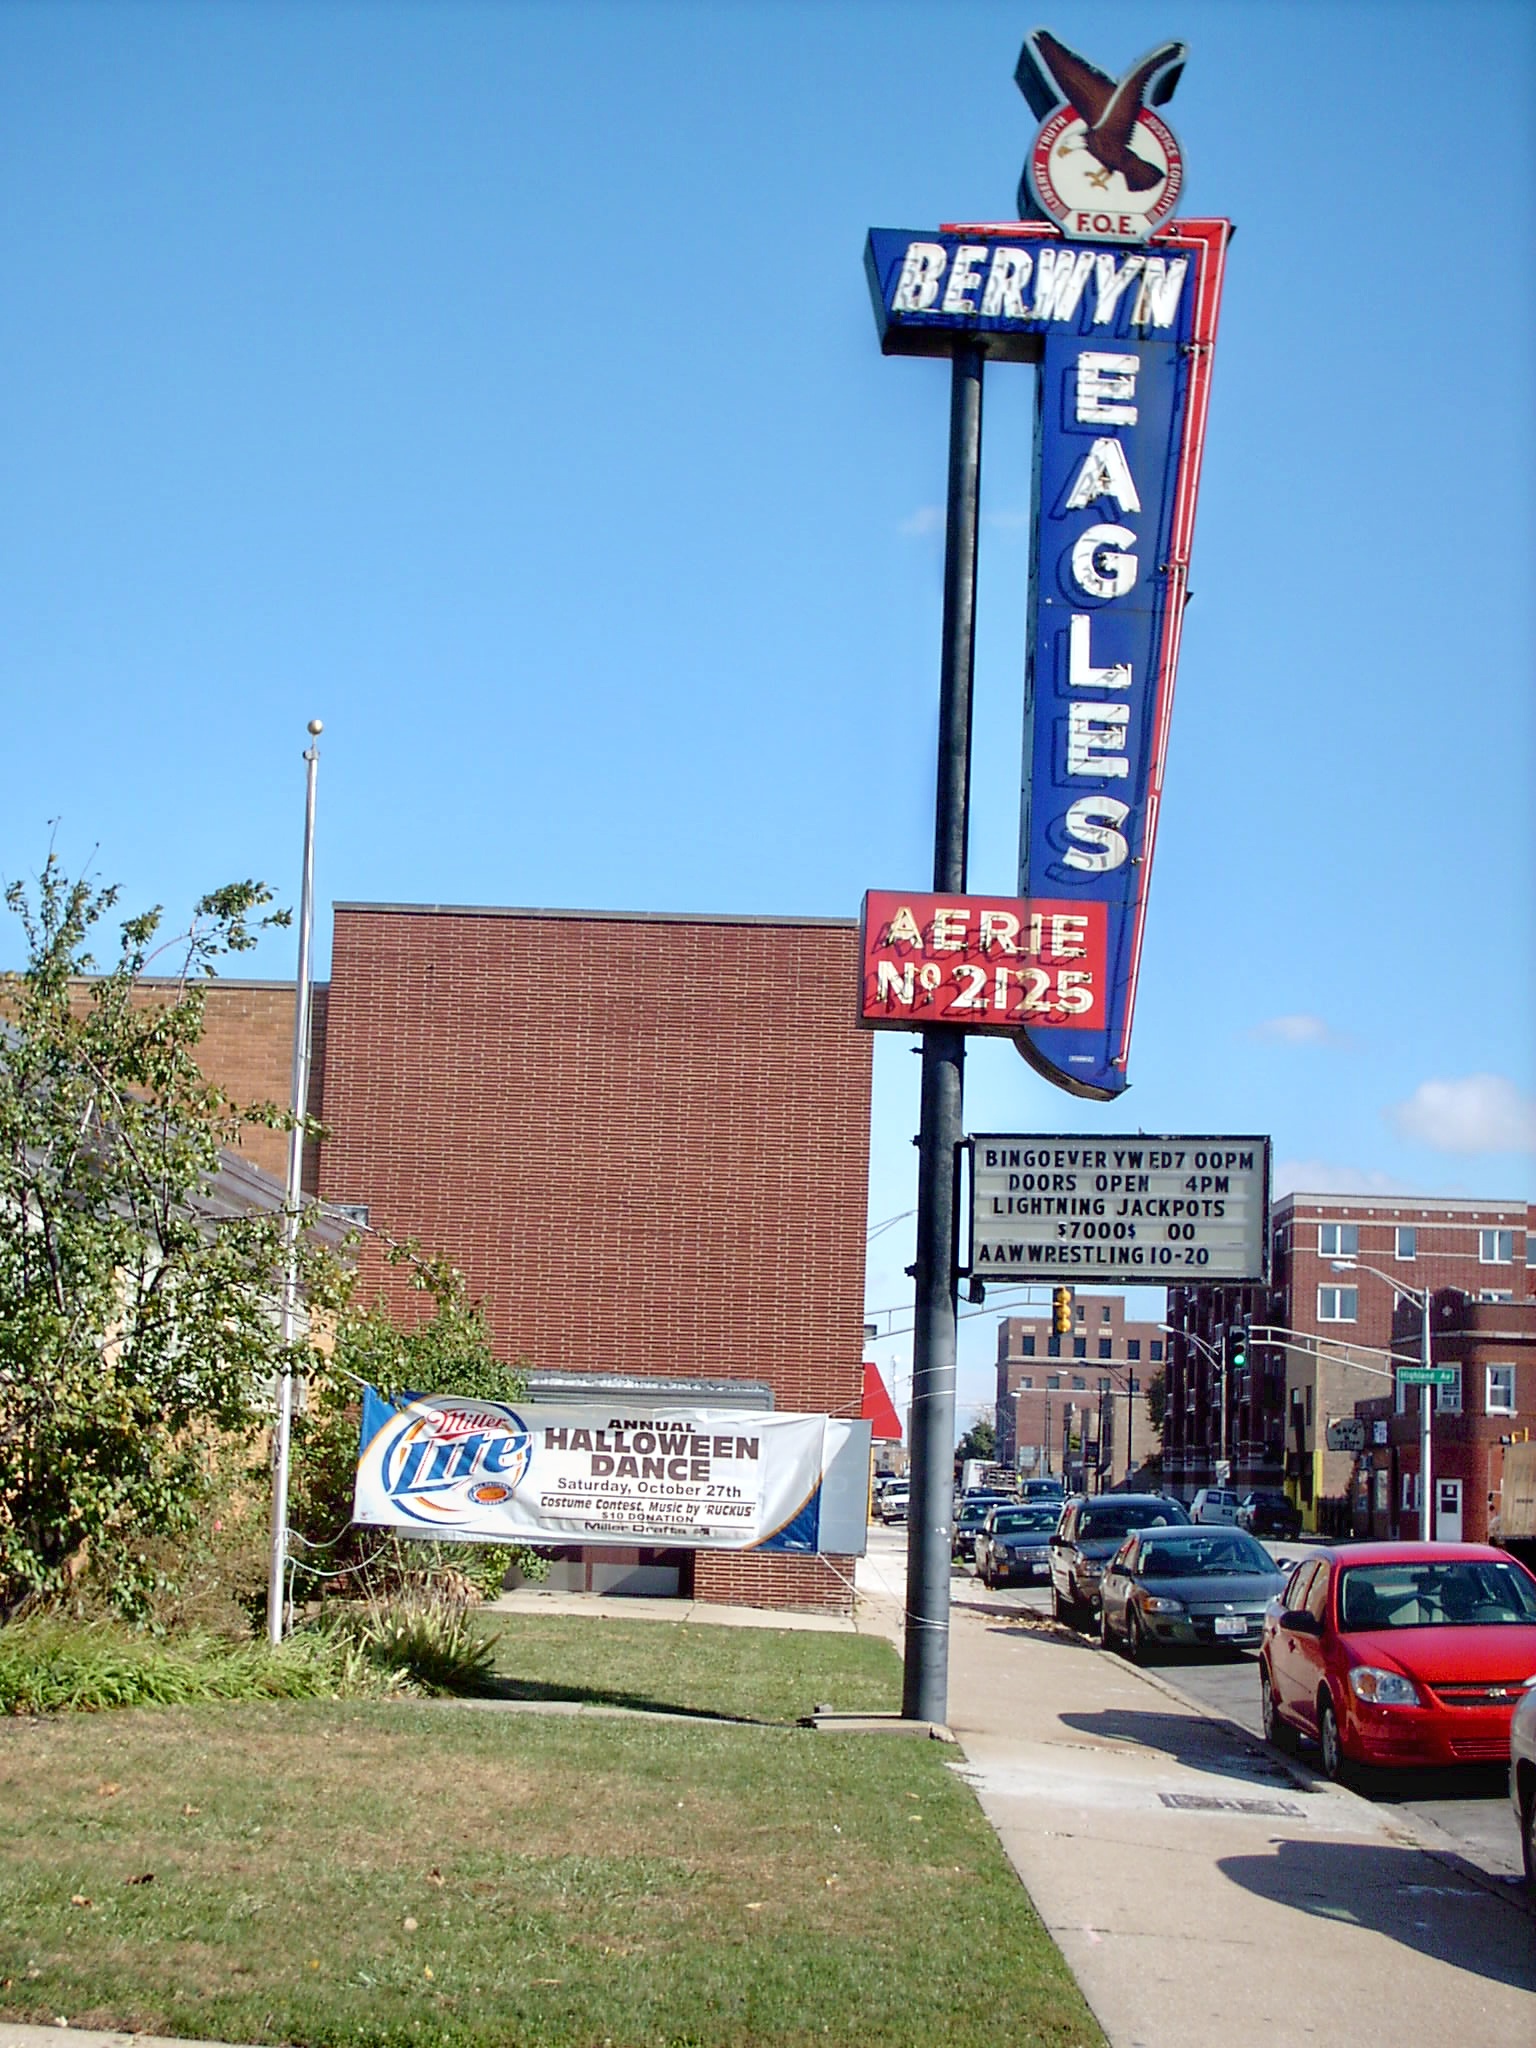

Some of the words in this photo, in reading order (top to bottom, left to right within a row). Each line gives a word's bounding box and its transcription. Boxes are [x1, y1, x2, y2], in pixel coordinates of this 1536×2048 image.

[1039, 115, 1068, 151] TRUTH
[1144, 116, 1178, 157] JUSTICE
[1034, 162, 1058, 211] LIBERTY
[1153, 163, 1181, 217] EQUALITY
[1077, 213, 1137, 235] F.O.E.
[892, 241, 1188, 328] BERWYN
[1062, 351, 1140, 872] EAGLES
[882, 906, 1088, 958] AERIE
[951, 964, 1094, 1014] 2125
[1009, 1174, 1077, 1191] DOORS
[1095, 1175, 1149, 1192] OPEN
[1185, 1176, 1229, 1193] 4PM
[993, 1197, 1105, 1215] LIGHTNING
[1116, 1198, 1225, 1217] JACKPOTS
[1168, 1223, 1195, 1240] 00
[427, 1409, 510, 1434] Miller
[608, 1419, 696, 1432] ANNUAL
[544, 1427, 760, 1460] HALLOWEEN
[390, 1433, 528, 1496] Lite
[591, 1454, 710, 1482] DANCE
[557, 1477, 632, 1495] Saturday,
[637, 1481, 702, 1496] October
[706, 1484, 742, 1498] 27th
[541, 1496, 592, 1509] Costume
[648, 1501, 682, 1513] Music
[686, 1503, 700, 1516] by
[602, 1511, 624, 1520] $10
[628, 1512, 694, 1524] DONATION
[584, 1522, 628, 1532] Miller
